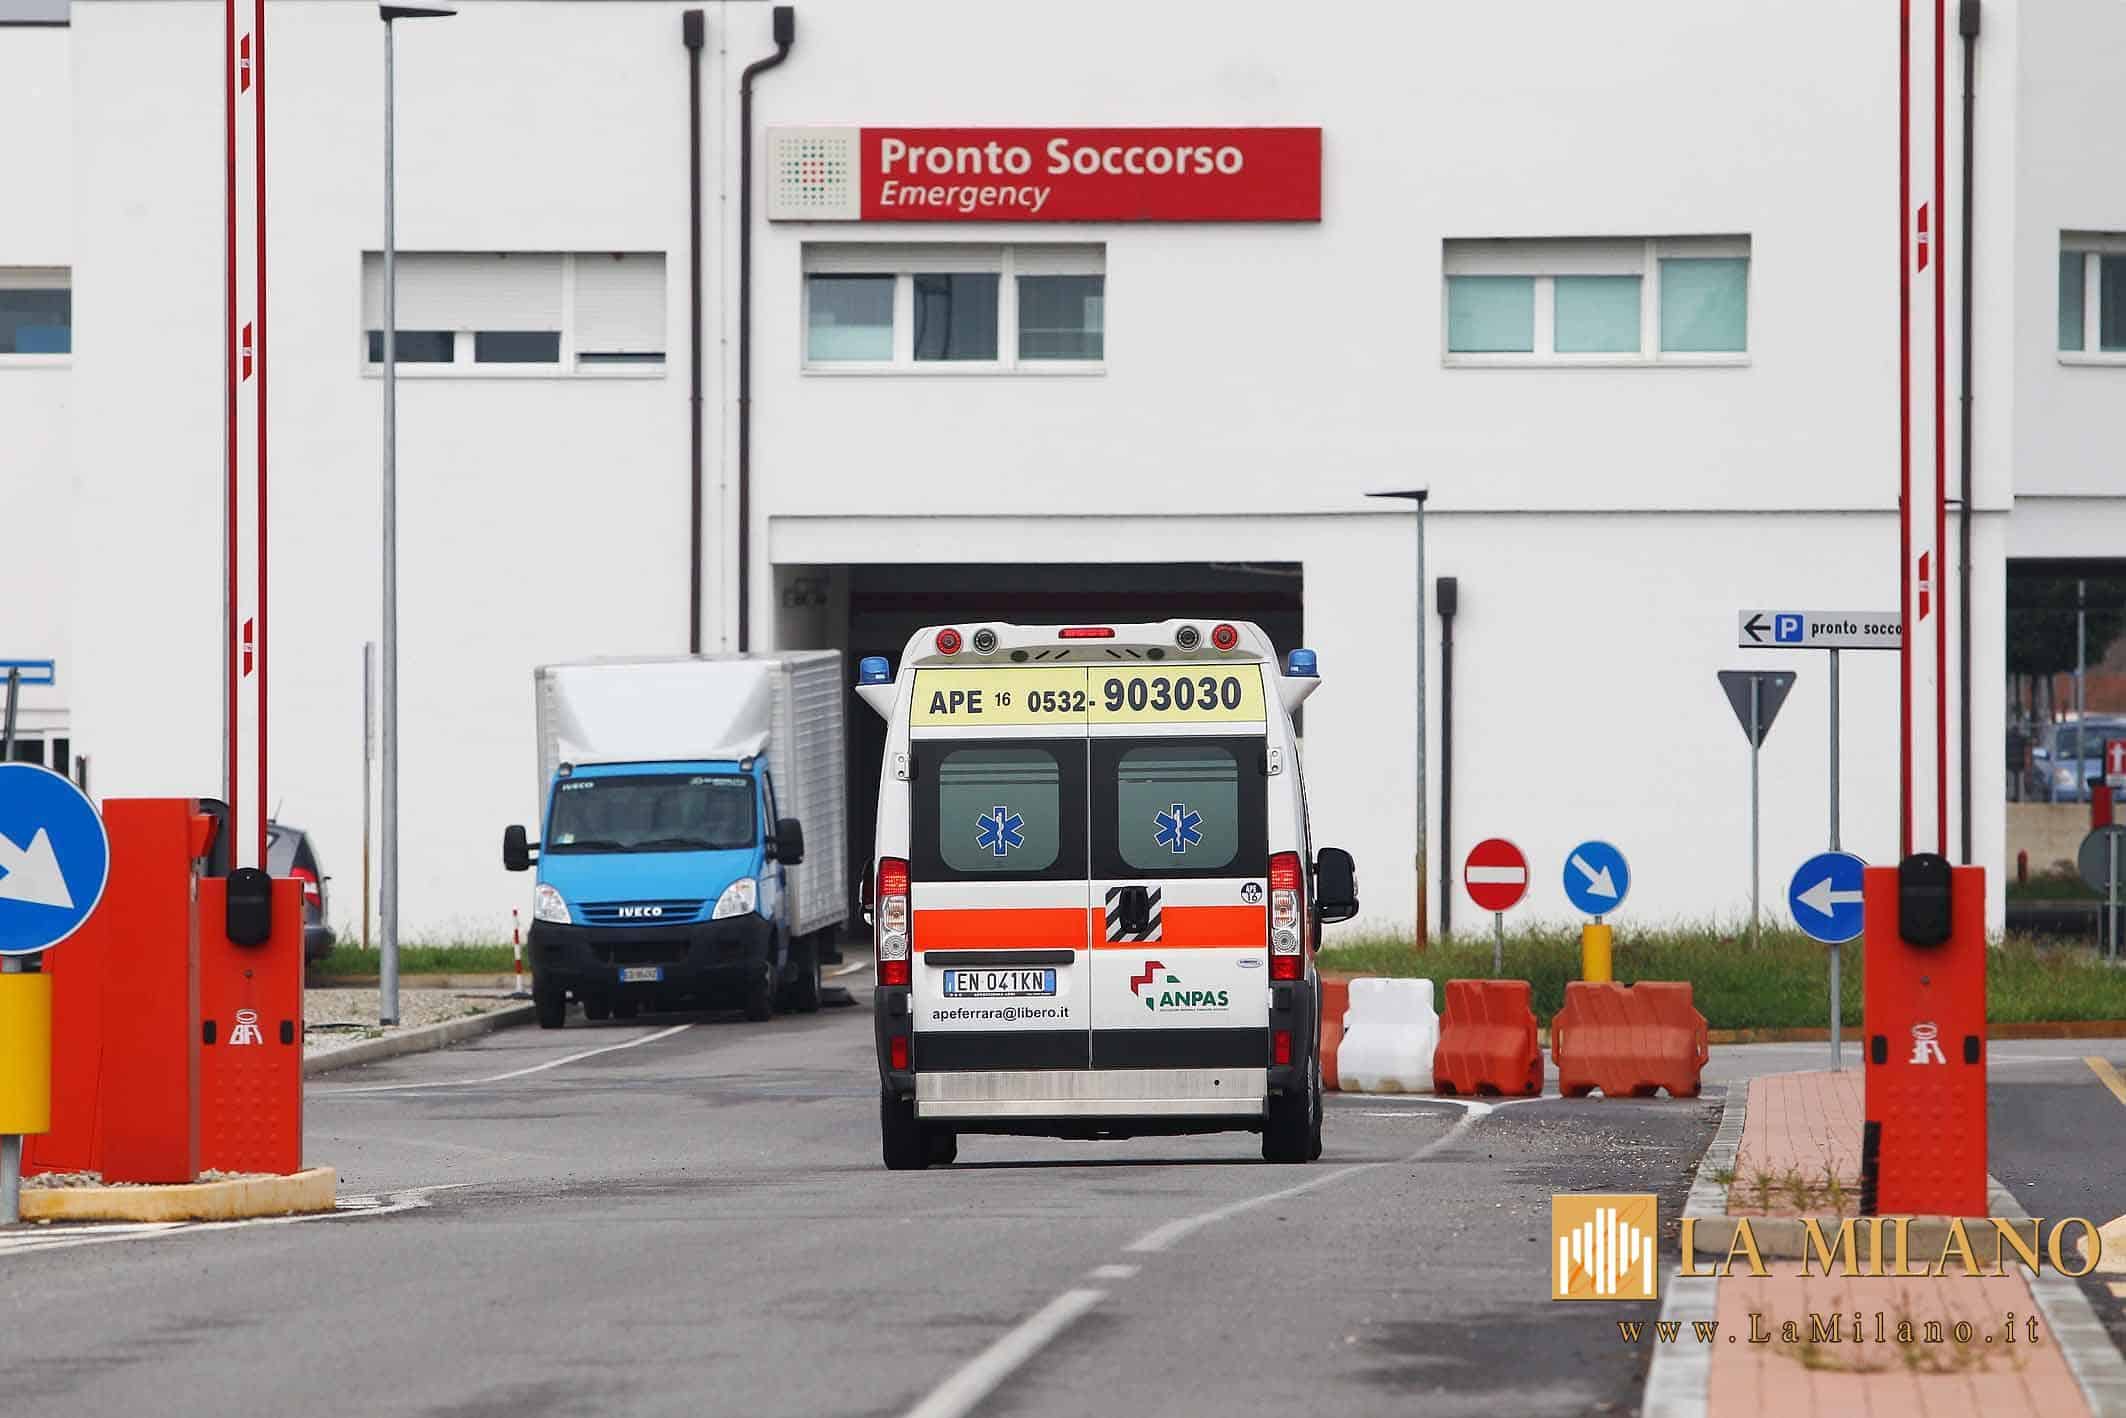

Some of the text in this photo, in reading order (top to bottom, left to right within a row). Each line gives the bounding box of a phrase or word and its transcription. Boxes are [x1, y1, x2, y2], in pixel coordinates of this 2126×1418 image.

[880, 138, 1244, 175] Pronto Soccorso
[880, 180, 1051, 212] Emergency
[1780, 618, 1798, 639] P
[1811, 620, 1857, 638] pronto
[929, 690, 983, 714] APE
[994, 692, 1012, 707] 16
[619, 907, 662, 918] IVECO
[957, 972, 1043, 991] EN 041KN
[1159, 990, 1229, 1007] ANPAS
[932, 1006, 1069, 1022] apeferrara@libero.it
